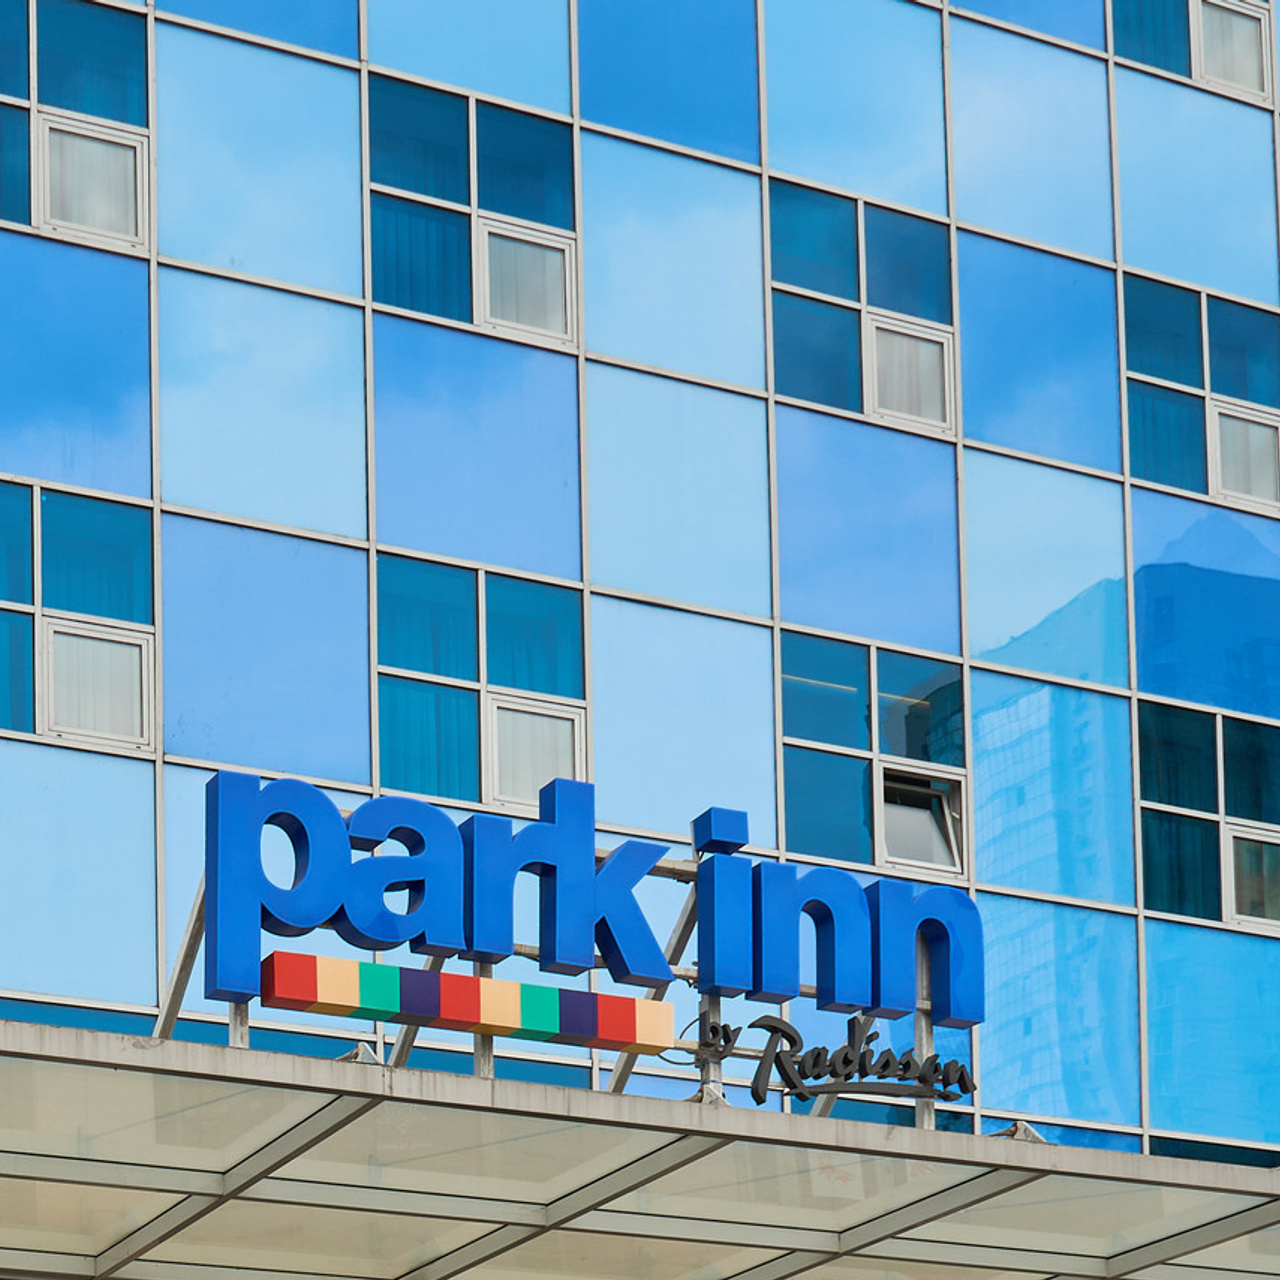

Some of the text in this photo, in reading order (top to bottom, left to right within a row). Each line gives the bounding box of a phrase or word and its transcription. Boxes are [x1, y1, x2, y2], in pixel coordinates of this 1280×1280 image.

[205, 770, 984, 1029] park inn
[747, 1015, 977, 1106] Radisson
